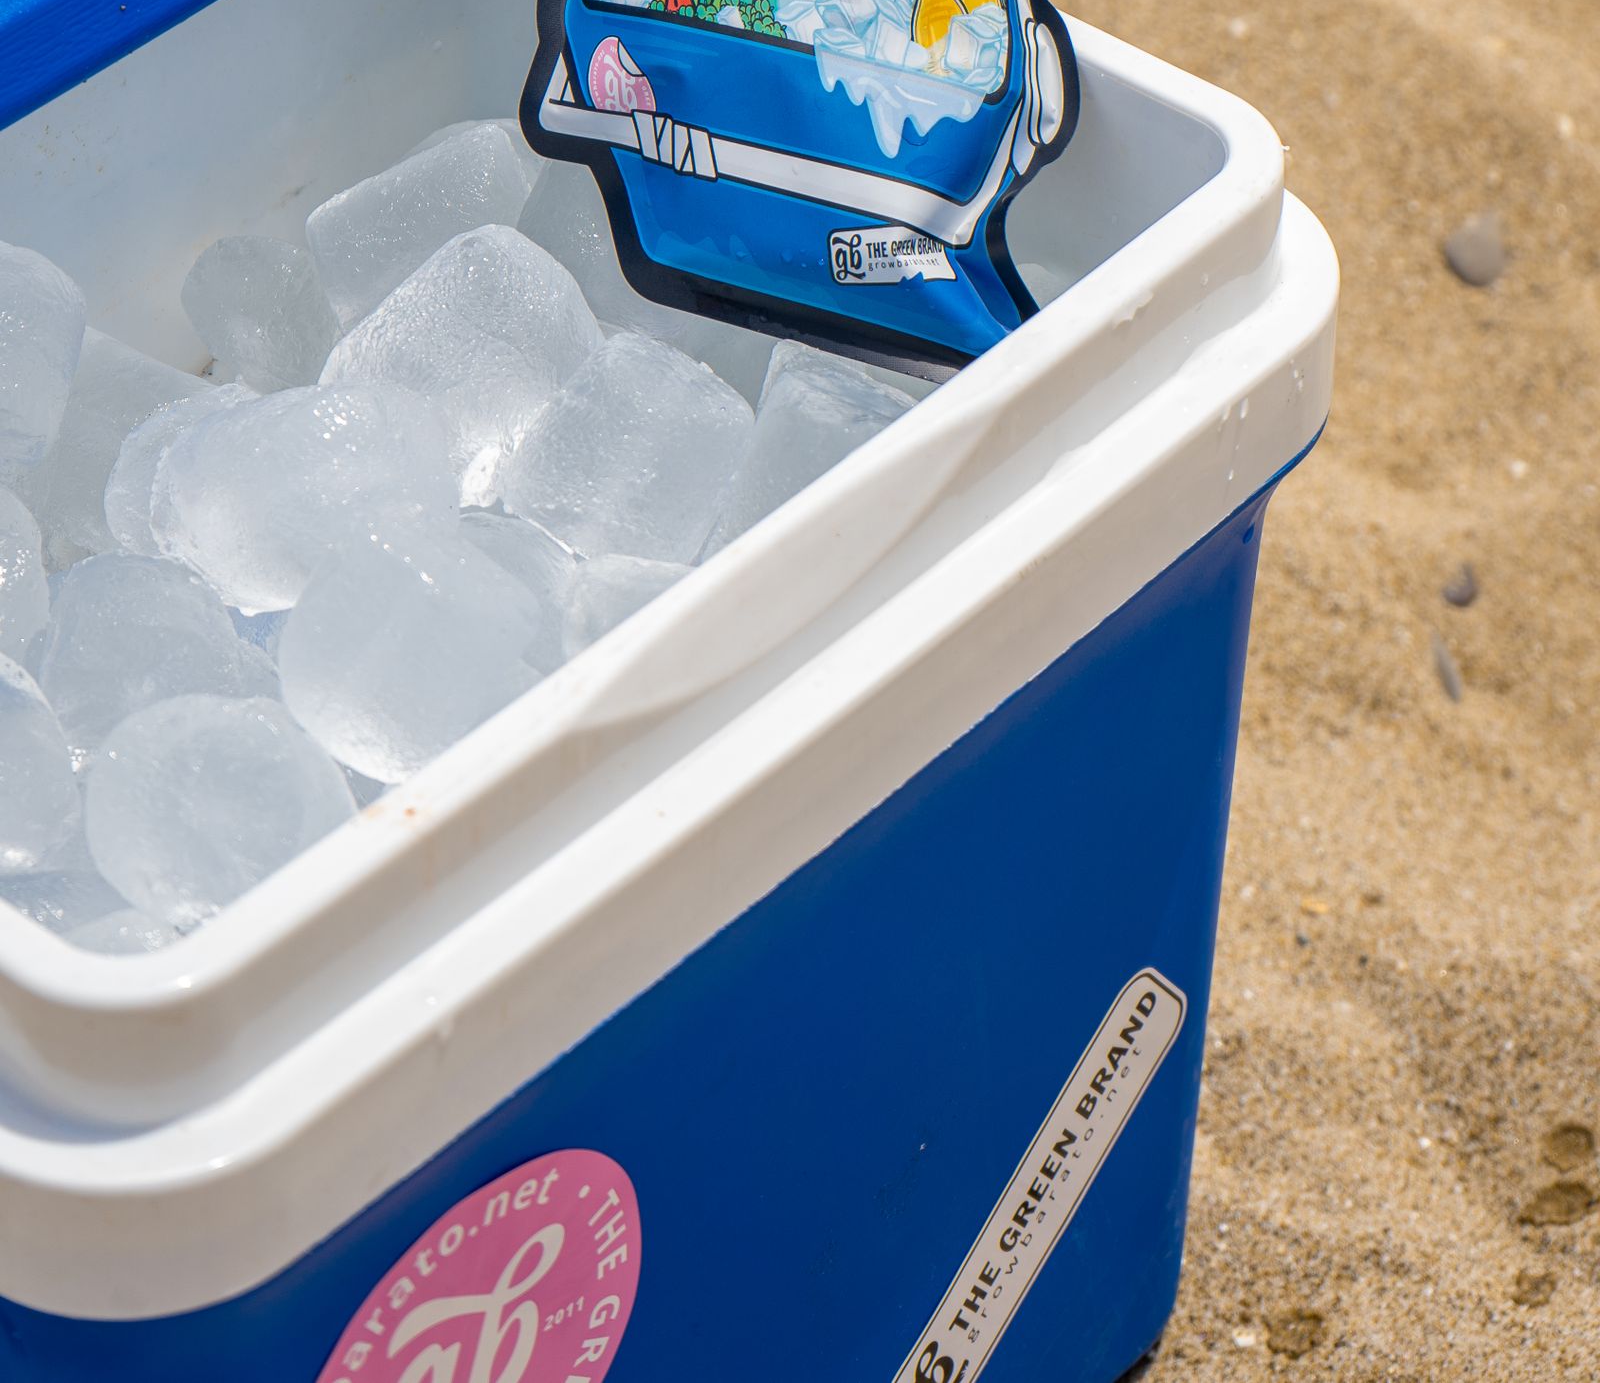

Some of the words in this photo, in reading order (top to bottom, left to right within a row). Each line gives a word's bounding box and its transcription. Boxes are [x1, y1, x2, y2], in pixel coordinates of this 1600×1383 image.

[832, 233, 866, 280] gb
[865, 241, 889, 259] THE
[891, 237, 917, 257] GREEN
[948, 1259, 1002, 1334] THE
[999, 1127, 1079, 1254] GREEN
[1074, 990, 1158, 1121] BRAND
[967, 1046, 1143, 1345] growbarato.net
[331, 1167, 561, 1383] arato.net
[587, 1187, 628, 1280] THE
[543, 1295, 585, 1332] 2011
